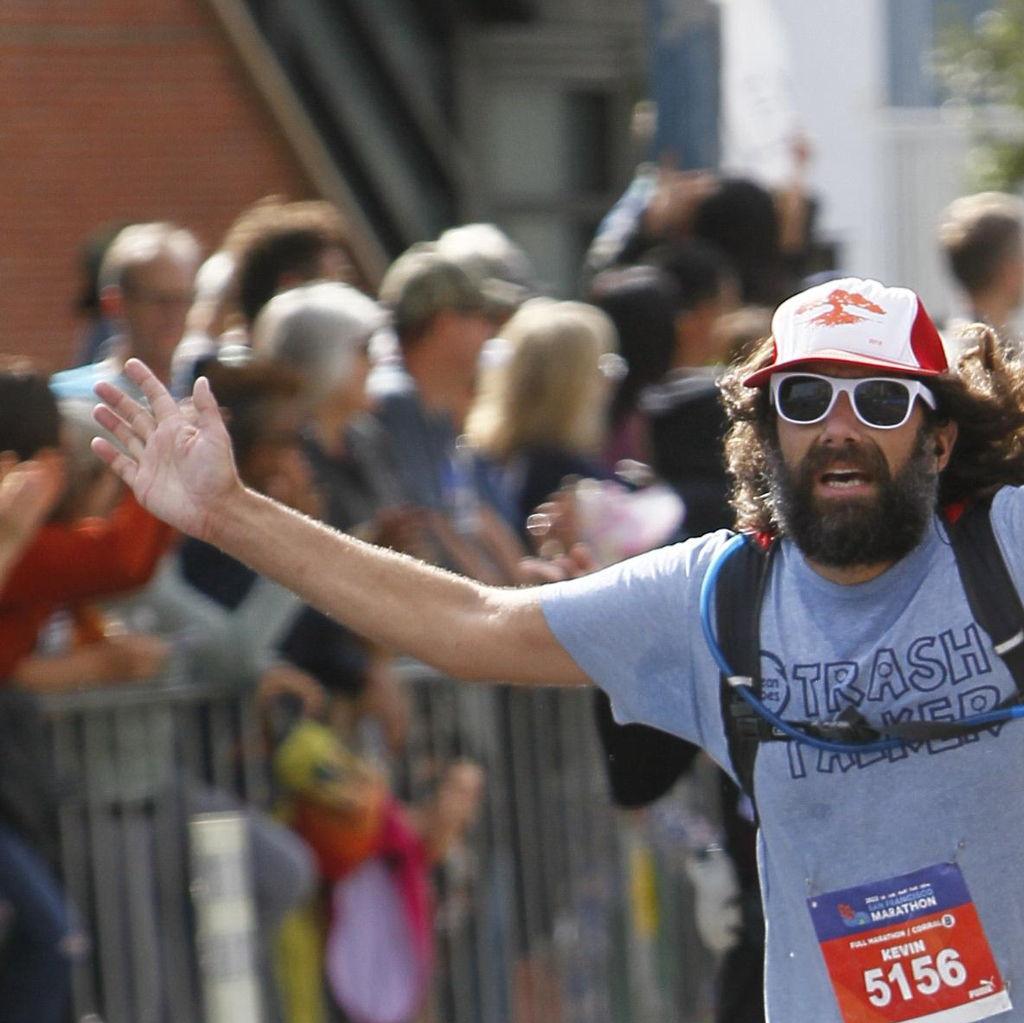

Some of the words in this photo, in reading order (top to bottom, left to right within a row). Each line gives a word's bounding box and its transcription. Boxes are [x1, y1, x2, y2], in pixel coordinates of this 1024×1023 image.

[792, 622, 992, 717] TRASH
[870, 895, 937, 922] MARATHON
[881, 939, 926, 962] KEVIN
[864, 948, 967, 1008] 5156
